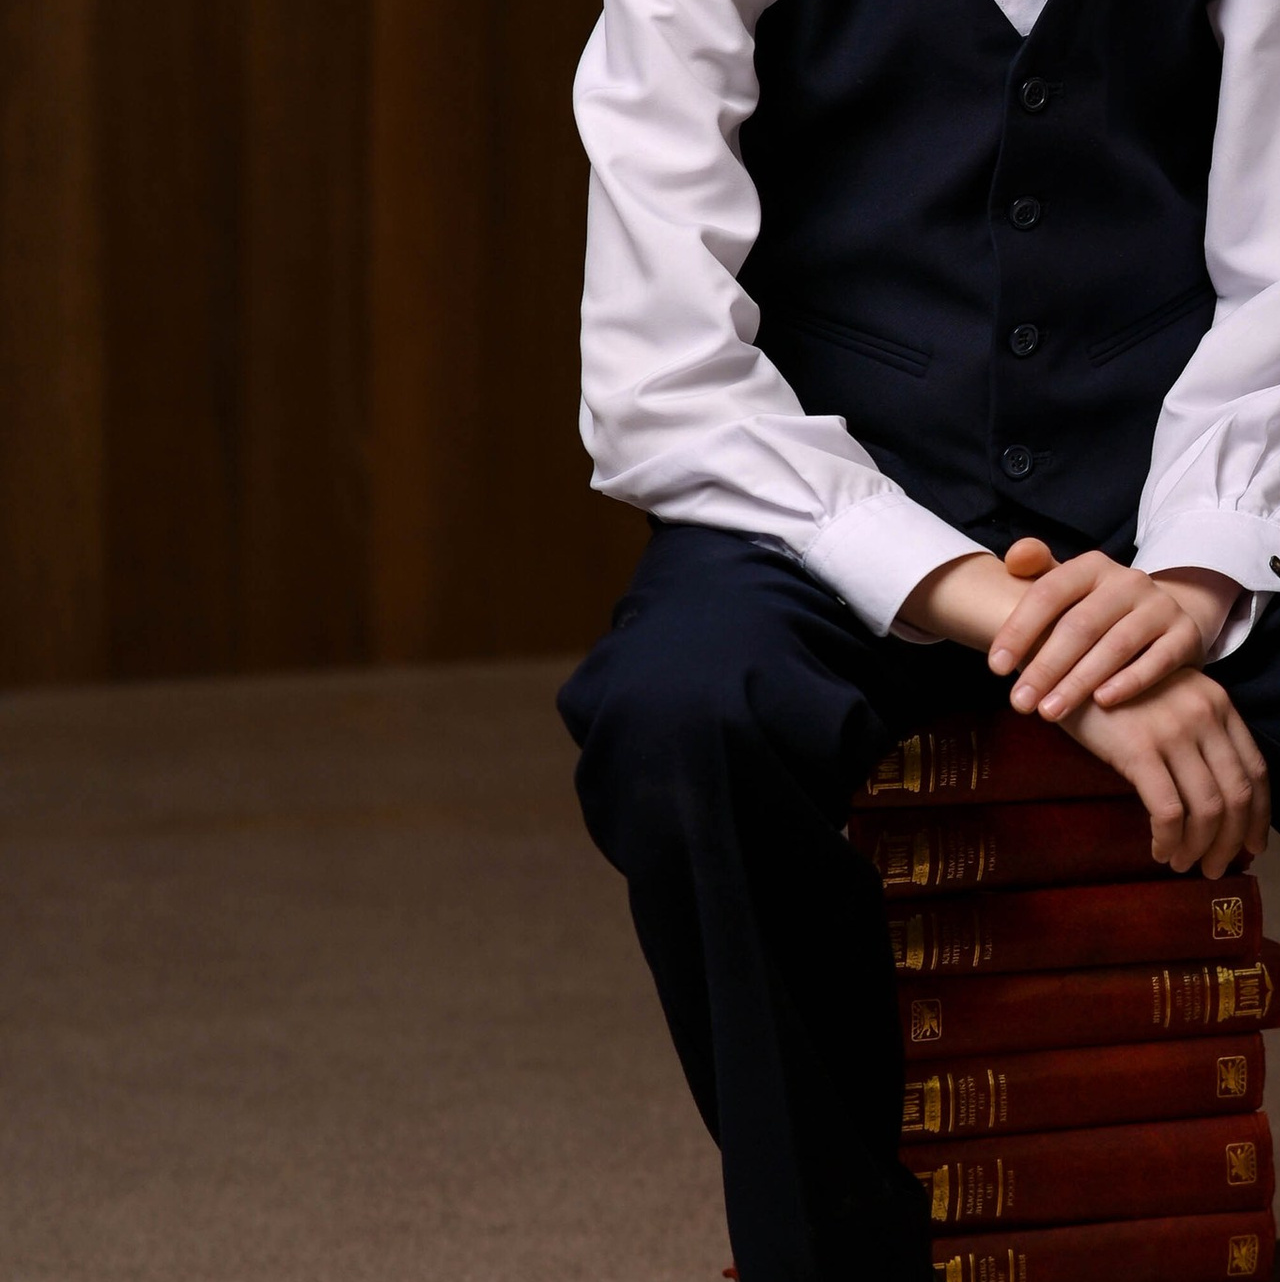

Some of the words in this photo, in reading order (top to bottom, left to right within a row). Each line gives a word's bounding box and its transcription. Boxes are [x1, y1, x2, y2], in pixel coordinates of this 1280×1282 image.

[1239, 978, 1260, 1007] МФГС
[958, 1077, 966, 1126] КЛАССИКА
[966, 1167, 975, 1215] КЛАССИКА
